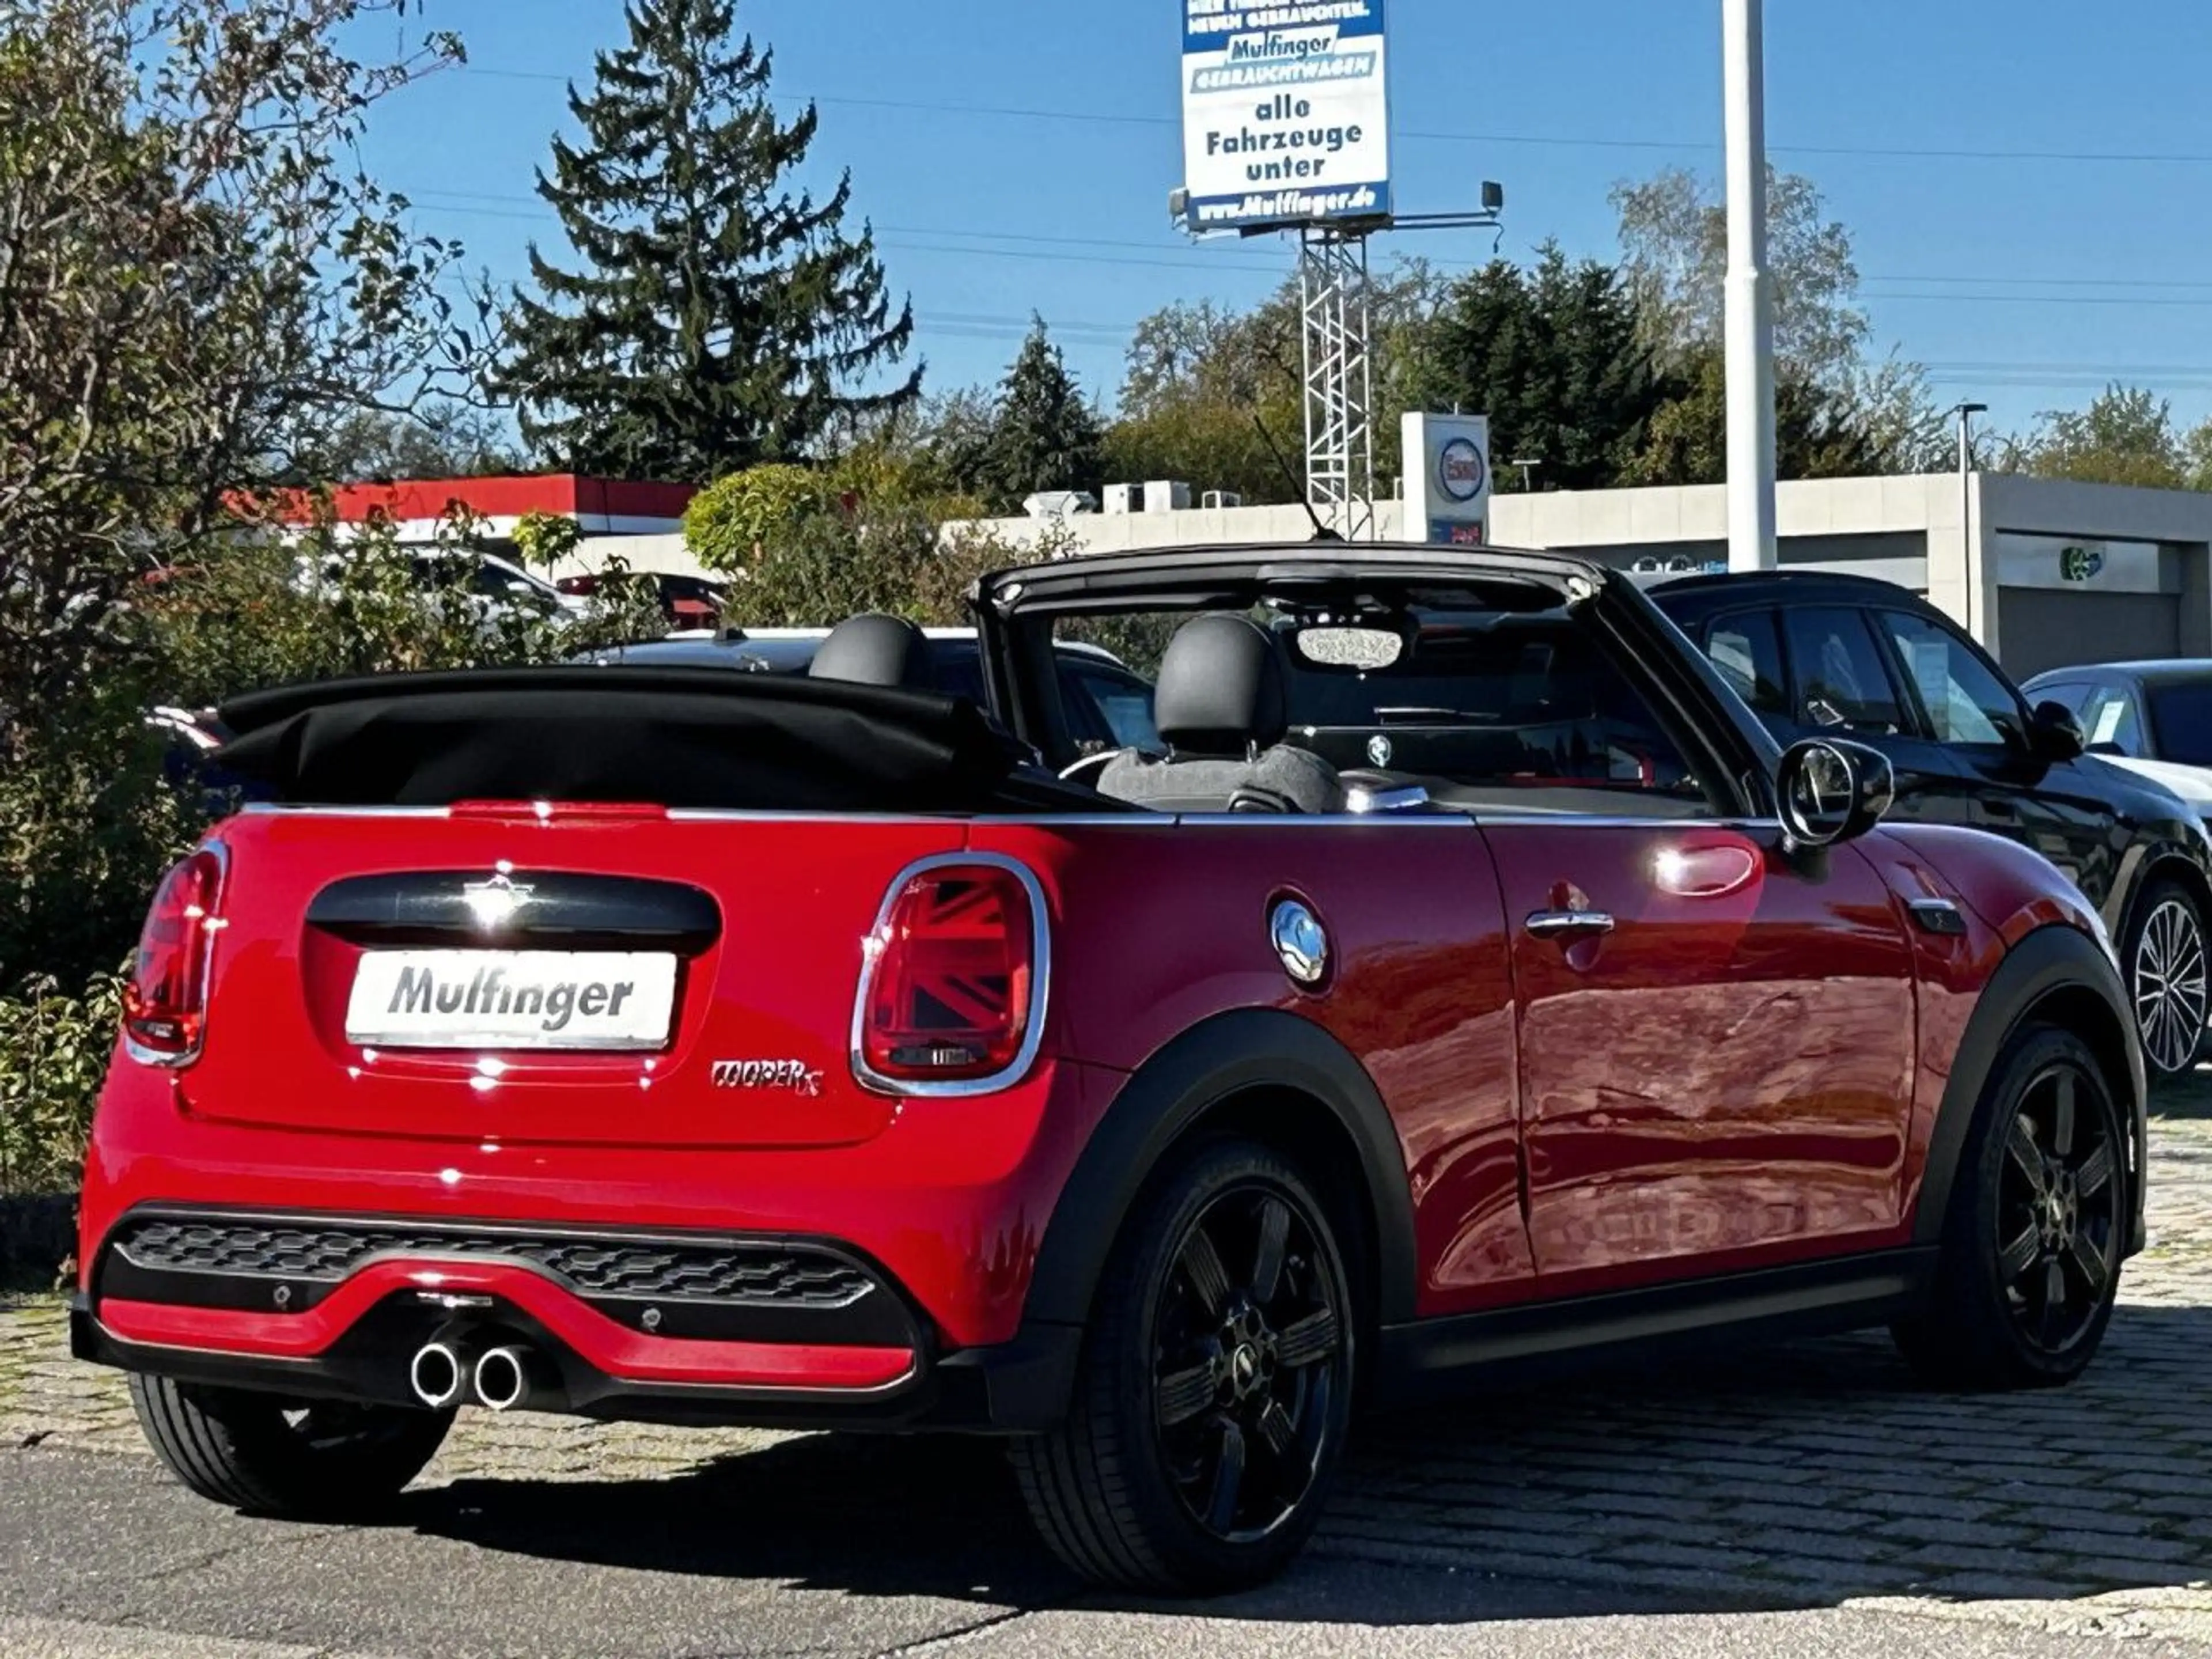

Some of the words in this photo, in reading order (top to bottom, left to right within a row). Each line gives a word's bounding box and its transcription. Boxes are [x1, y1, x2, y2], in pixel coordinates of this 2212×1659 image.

[1231, 31, 1332, 61] Mulfinger
[1195, 56, 1371, 89] GEBRAUCHTWAGEN
[1255, 93, 1310, 120] alle
[1206, 125, 1362, 156] Fahrzeuge
[1246, 156, 1325, 181] unter
[1198, 185, 1376, 220] www.Mulfinger.de
[387, 965, 634, 1031] Mulfinger
